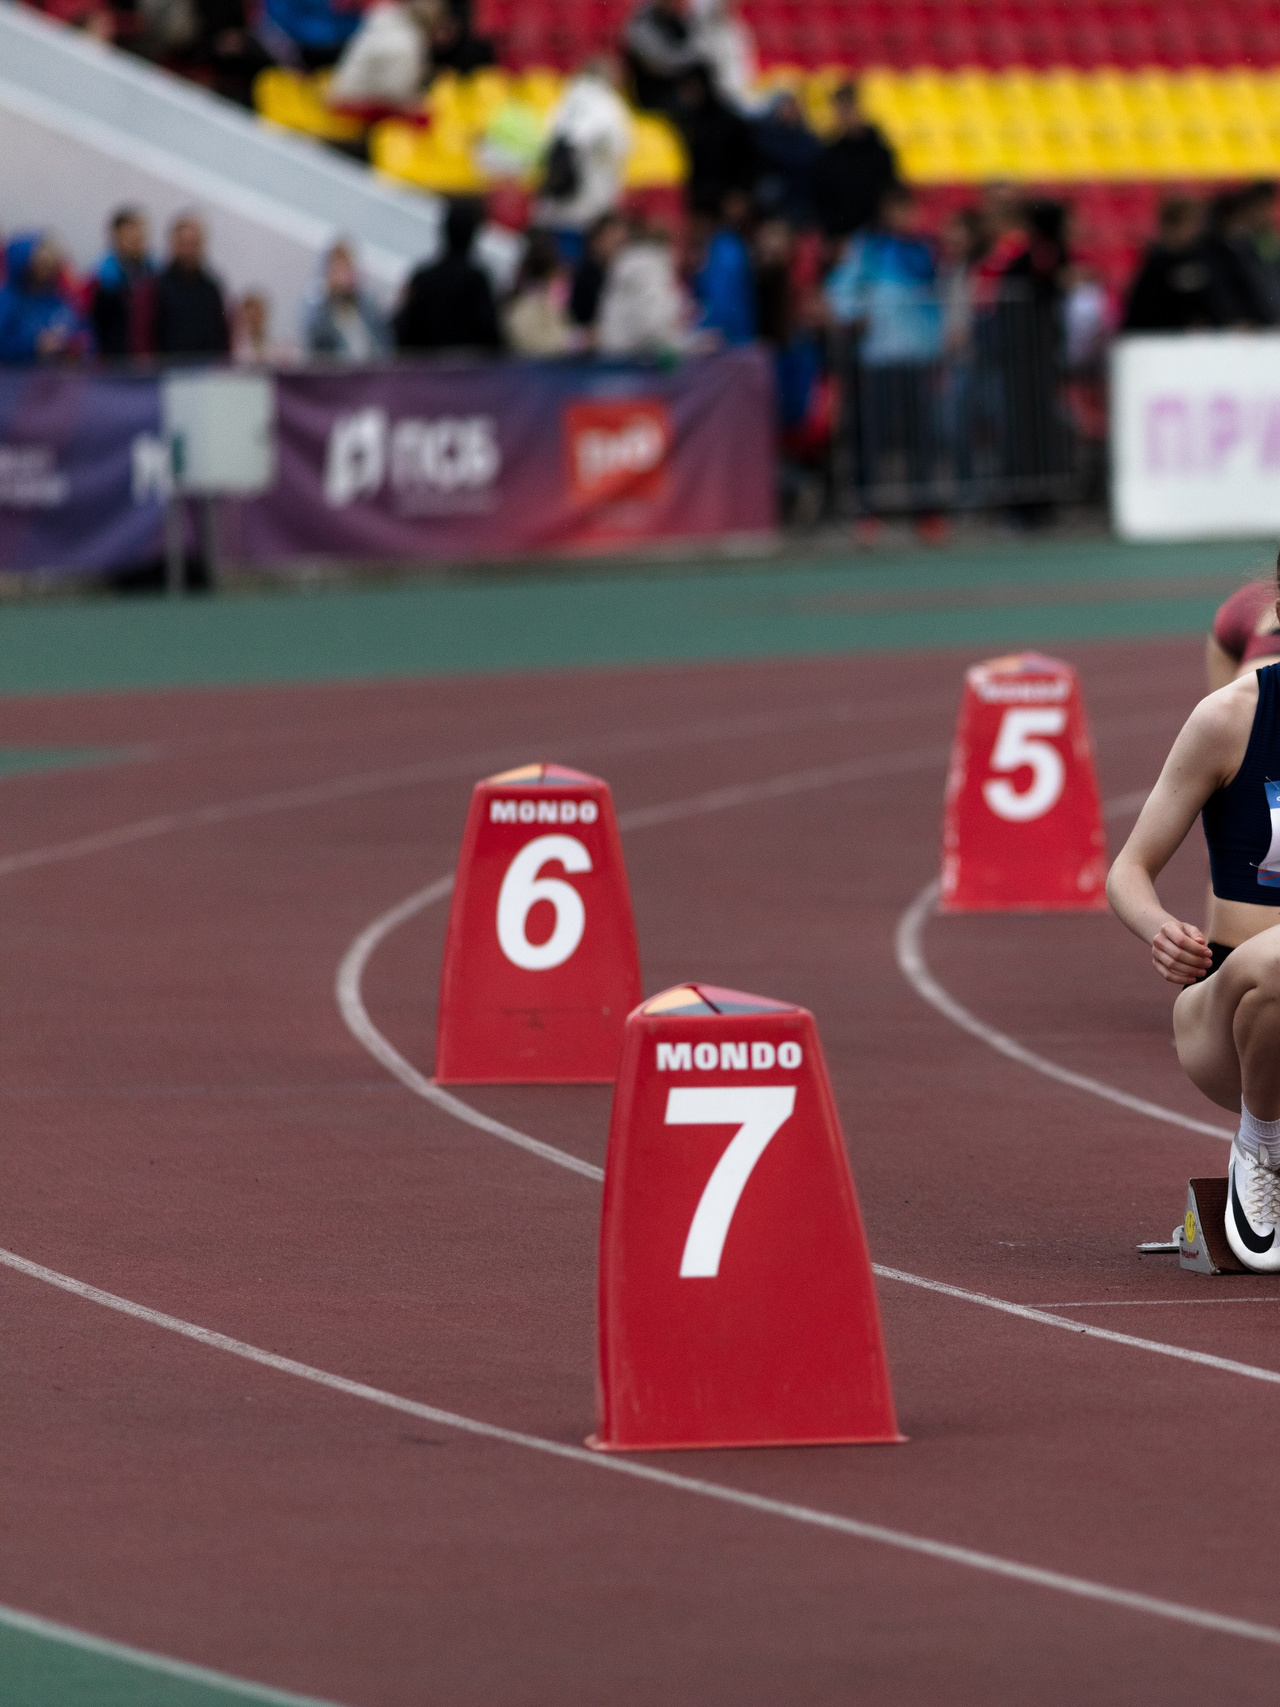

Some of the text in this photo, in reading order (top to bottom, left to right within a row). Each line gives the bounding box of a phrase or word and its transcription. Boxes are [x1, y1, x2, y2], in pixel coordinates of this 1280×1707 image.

[490, 800, 598, 825] MONDO
[981, 706, 1068, 823] 5
[496, 833, 593, 971] 6
[656, 1041, 803, 1072] MONDO
[664, 1085, 797, 1279] 7
